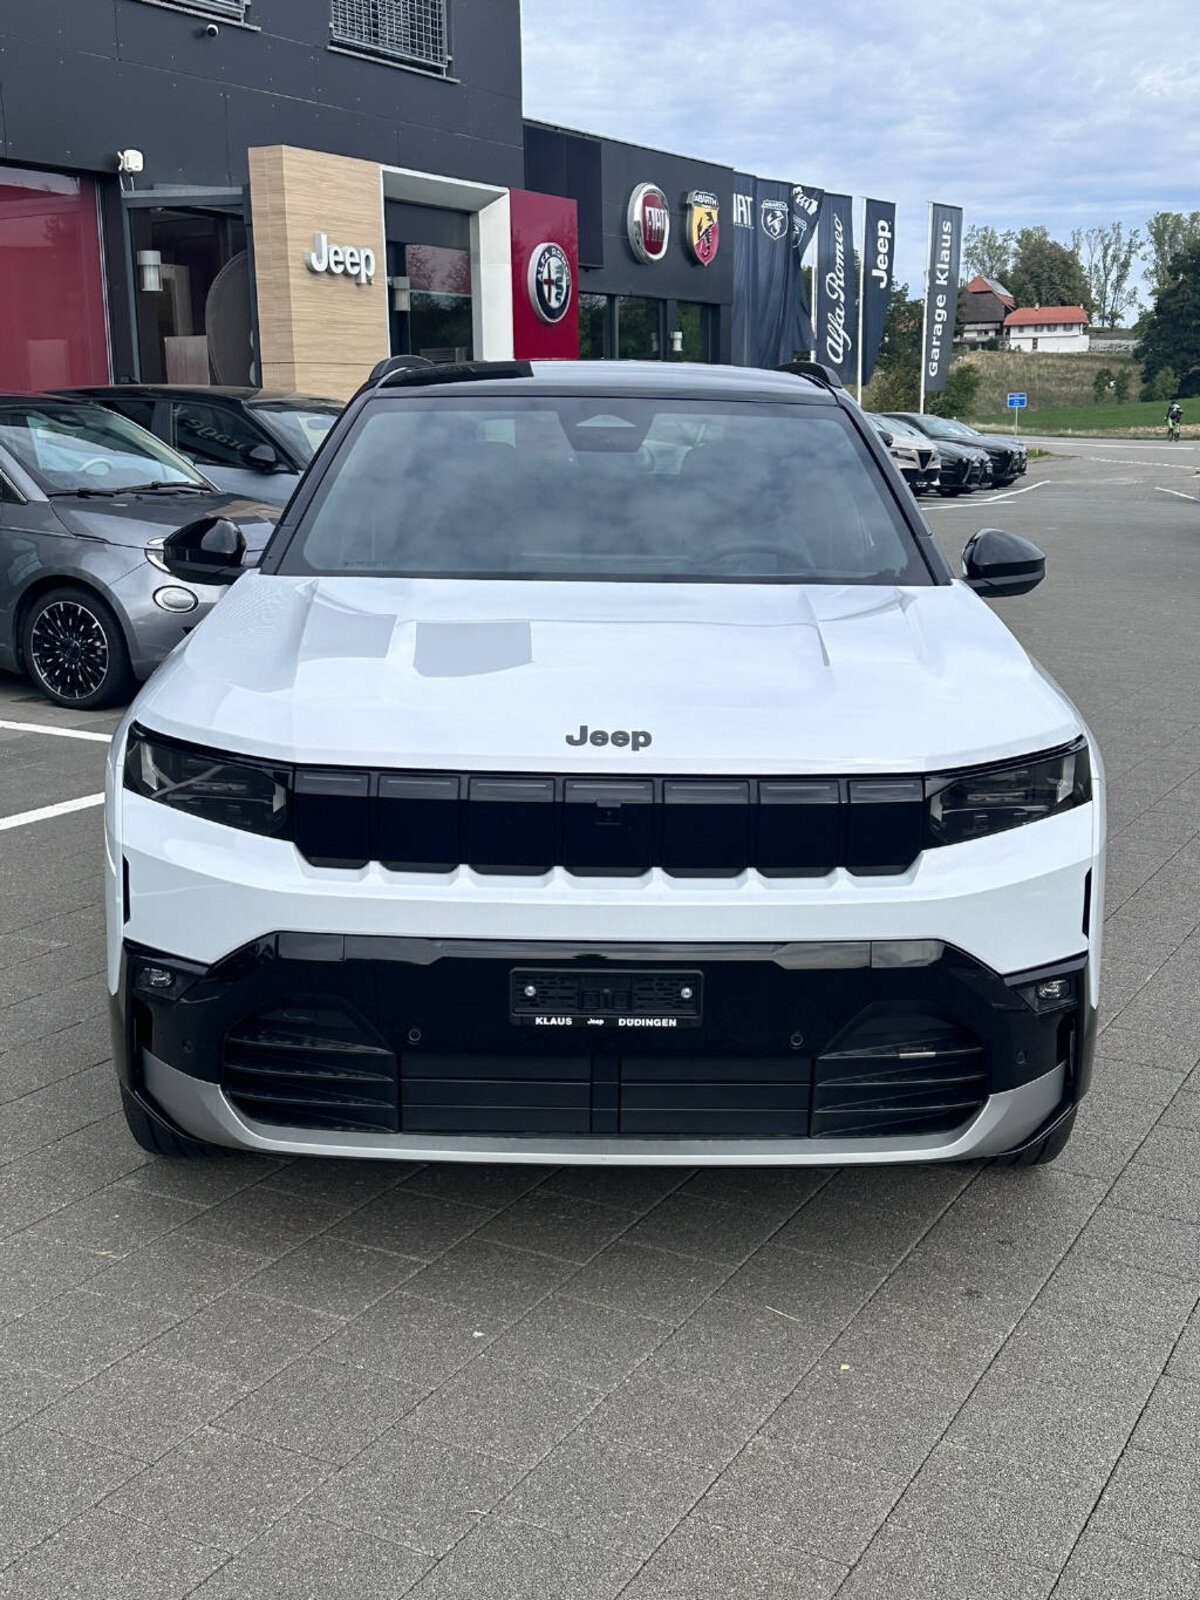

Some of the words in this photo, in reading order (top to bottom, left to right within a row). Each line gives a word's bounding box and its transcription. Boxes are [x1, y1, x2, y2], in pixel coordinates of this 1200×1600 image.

[645, 206, 668, 242] FIAT
[732, 193, 753, 226] IAT
[306, 232, 376, 284] Jeep
[825, 213, 846, 303] Romeo
[871, 219, 893, 289] Jeep
[935, 220, 952, 286] Klaus
[826, 302, 852, 365] Alfa
[928, 294, 947, 377] Garage
[565, 725, 652, 751] Jeep
[535, 1017, 573, 1026] KLAUS
[587, 1018, 604, 1026] Jeep
